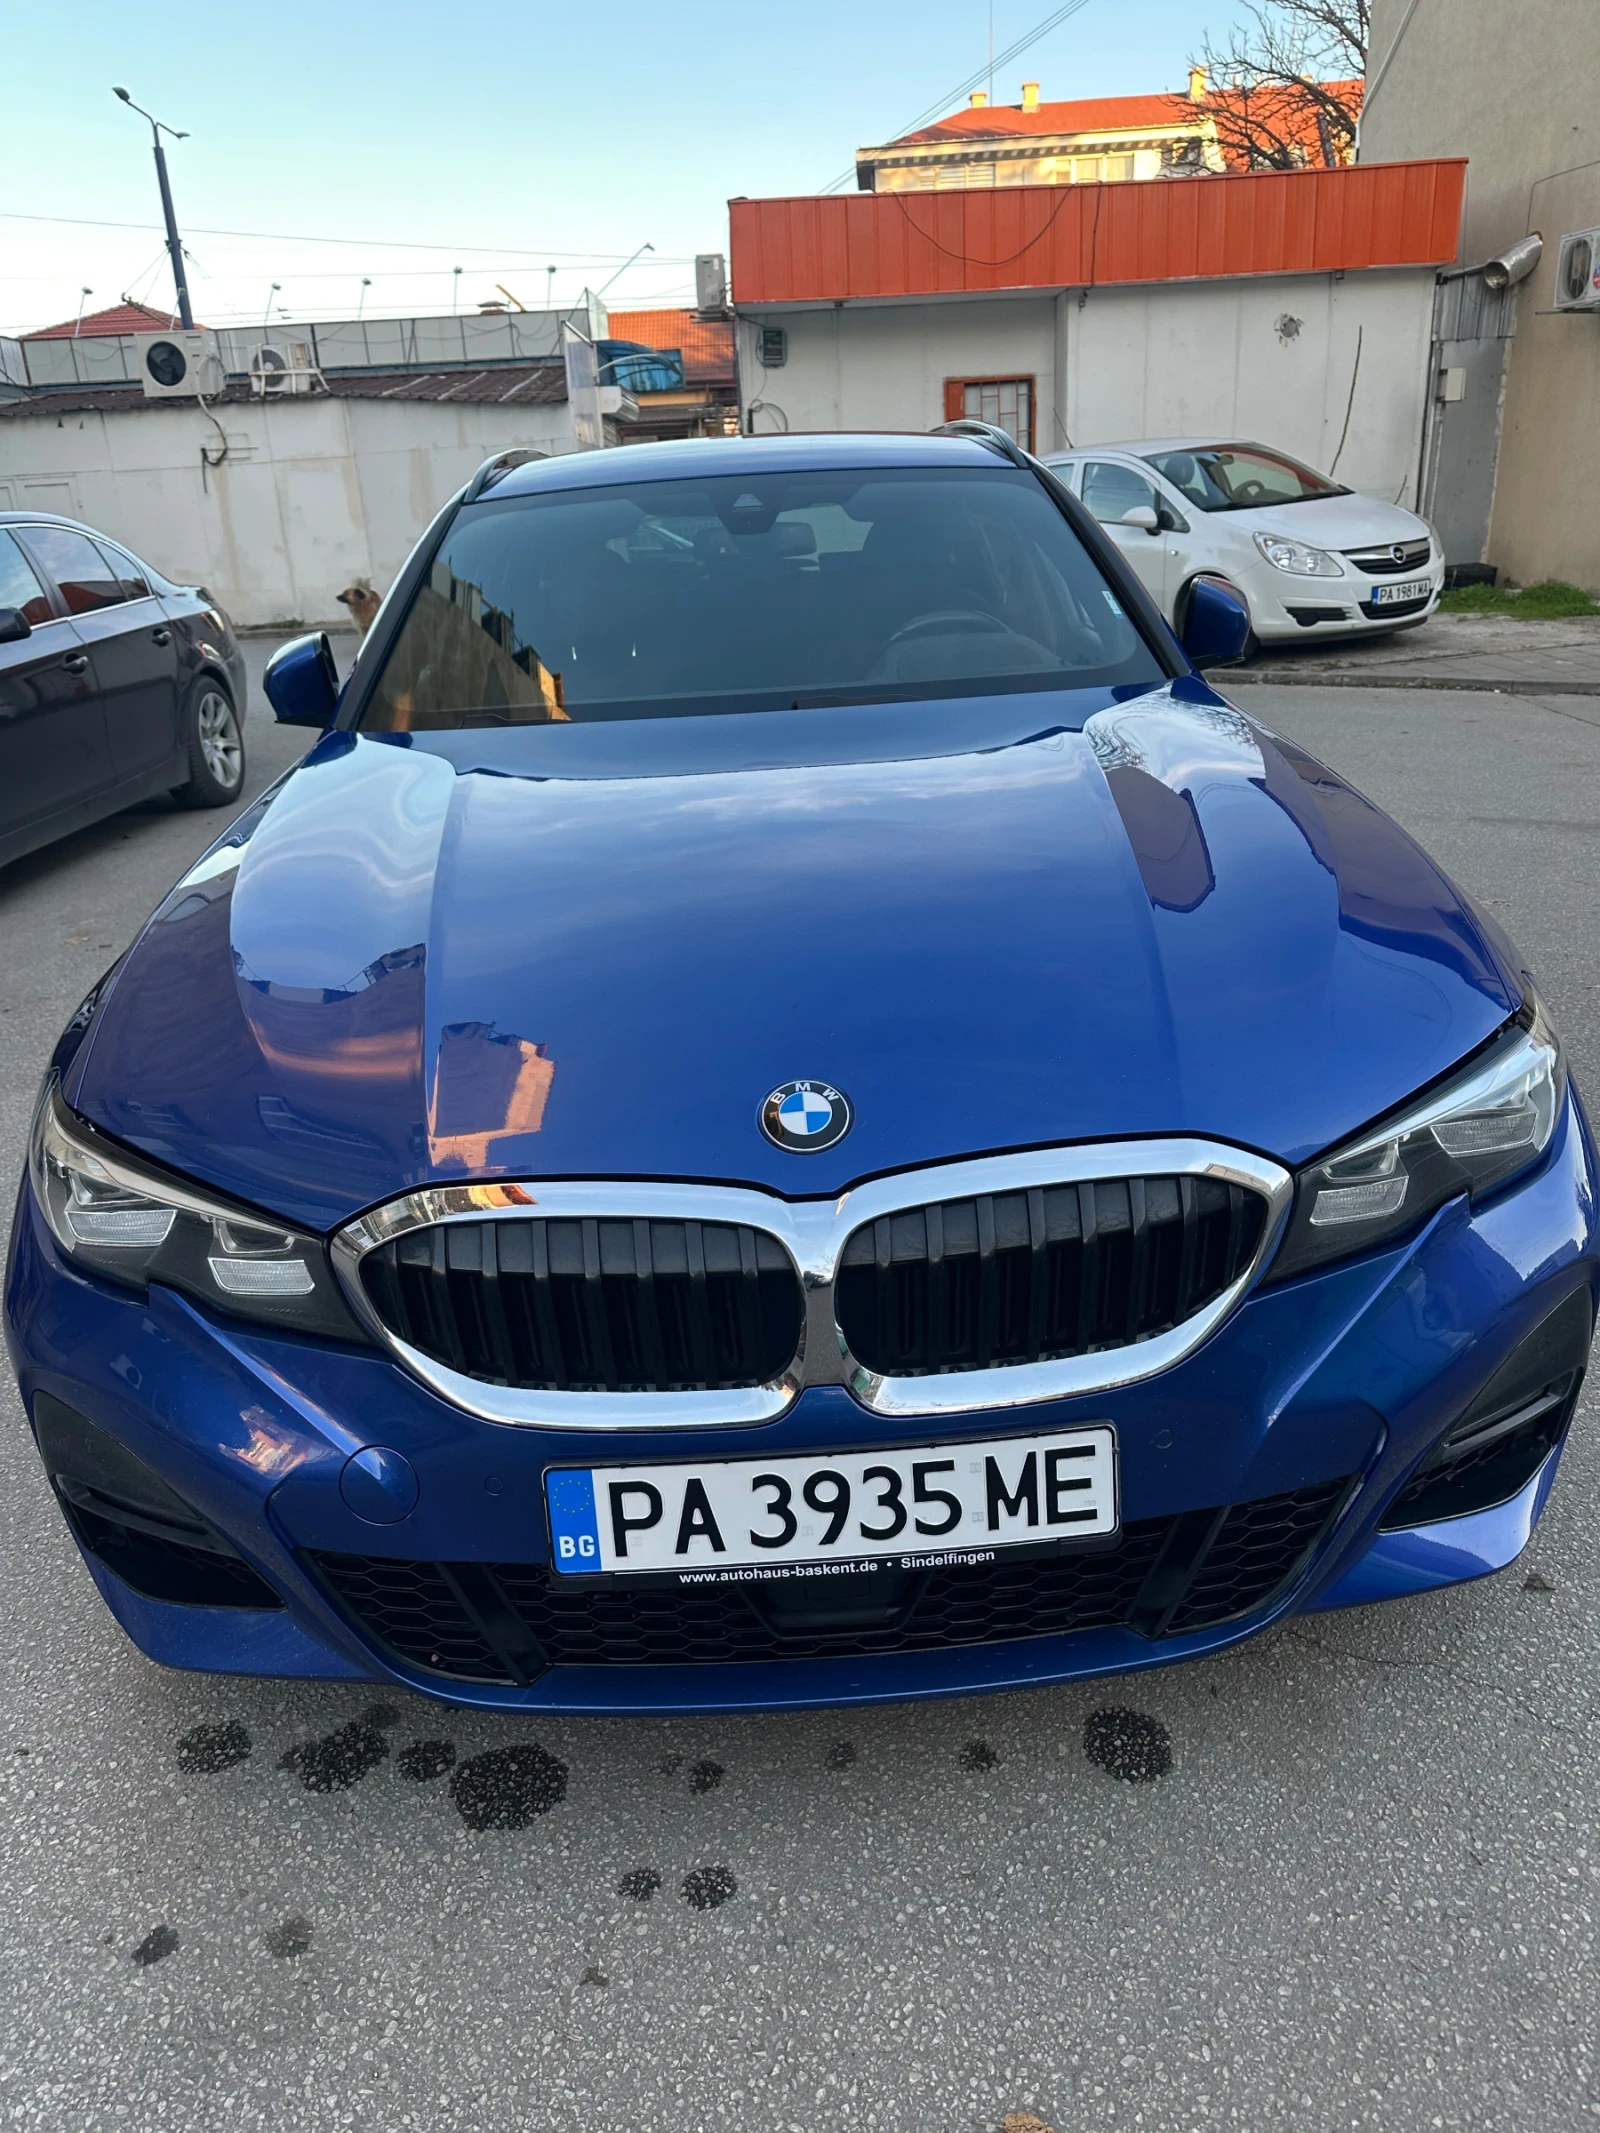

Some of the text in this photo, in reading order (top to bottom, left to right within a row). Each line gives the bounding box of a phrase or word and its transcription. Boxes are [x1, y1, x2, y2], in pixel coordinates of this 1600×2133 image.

[1379, 587, 1394, 602] PA
[770, 1082, 840, 1105] BMW
[608, 1444, 1098, 1557] PA 3935 ME
[559, 1535, 595, 1559] BG
[679, 1551, 995, 1584] www.autohaus-baskent.de Sindelfingen
